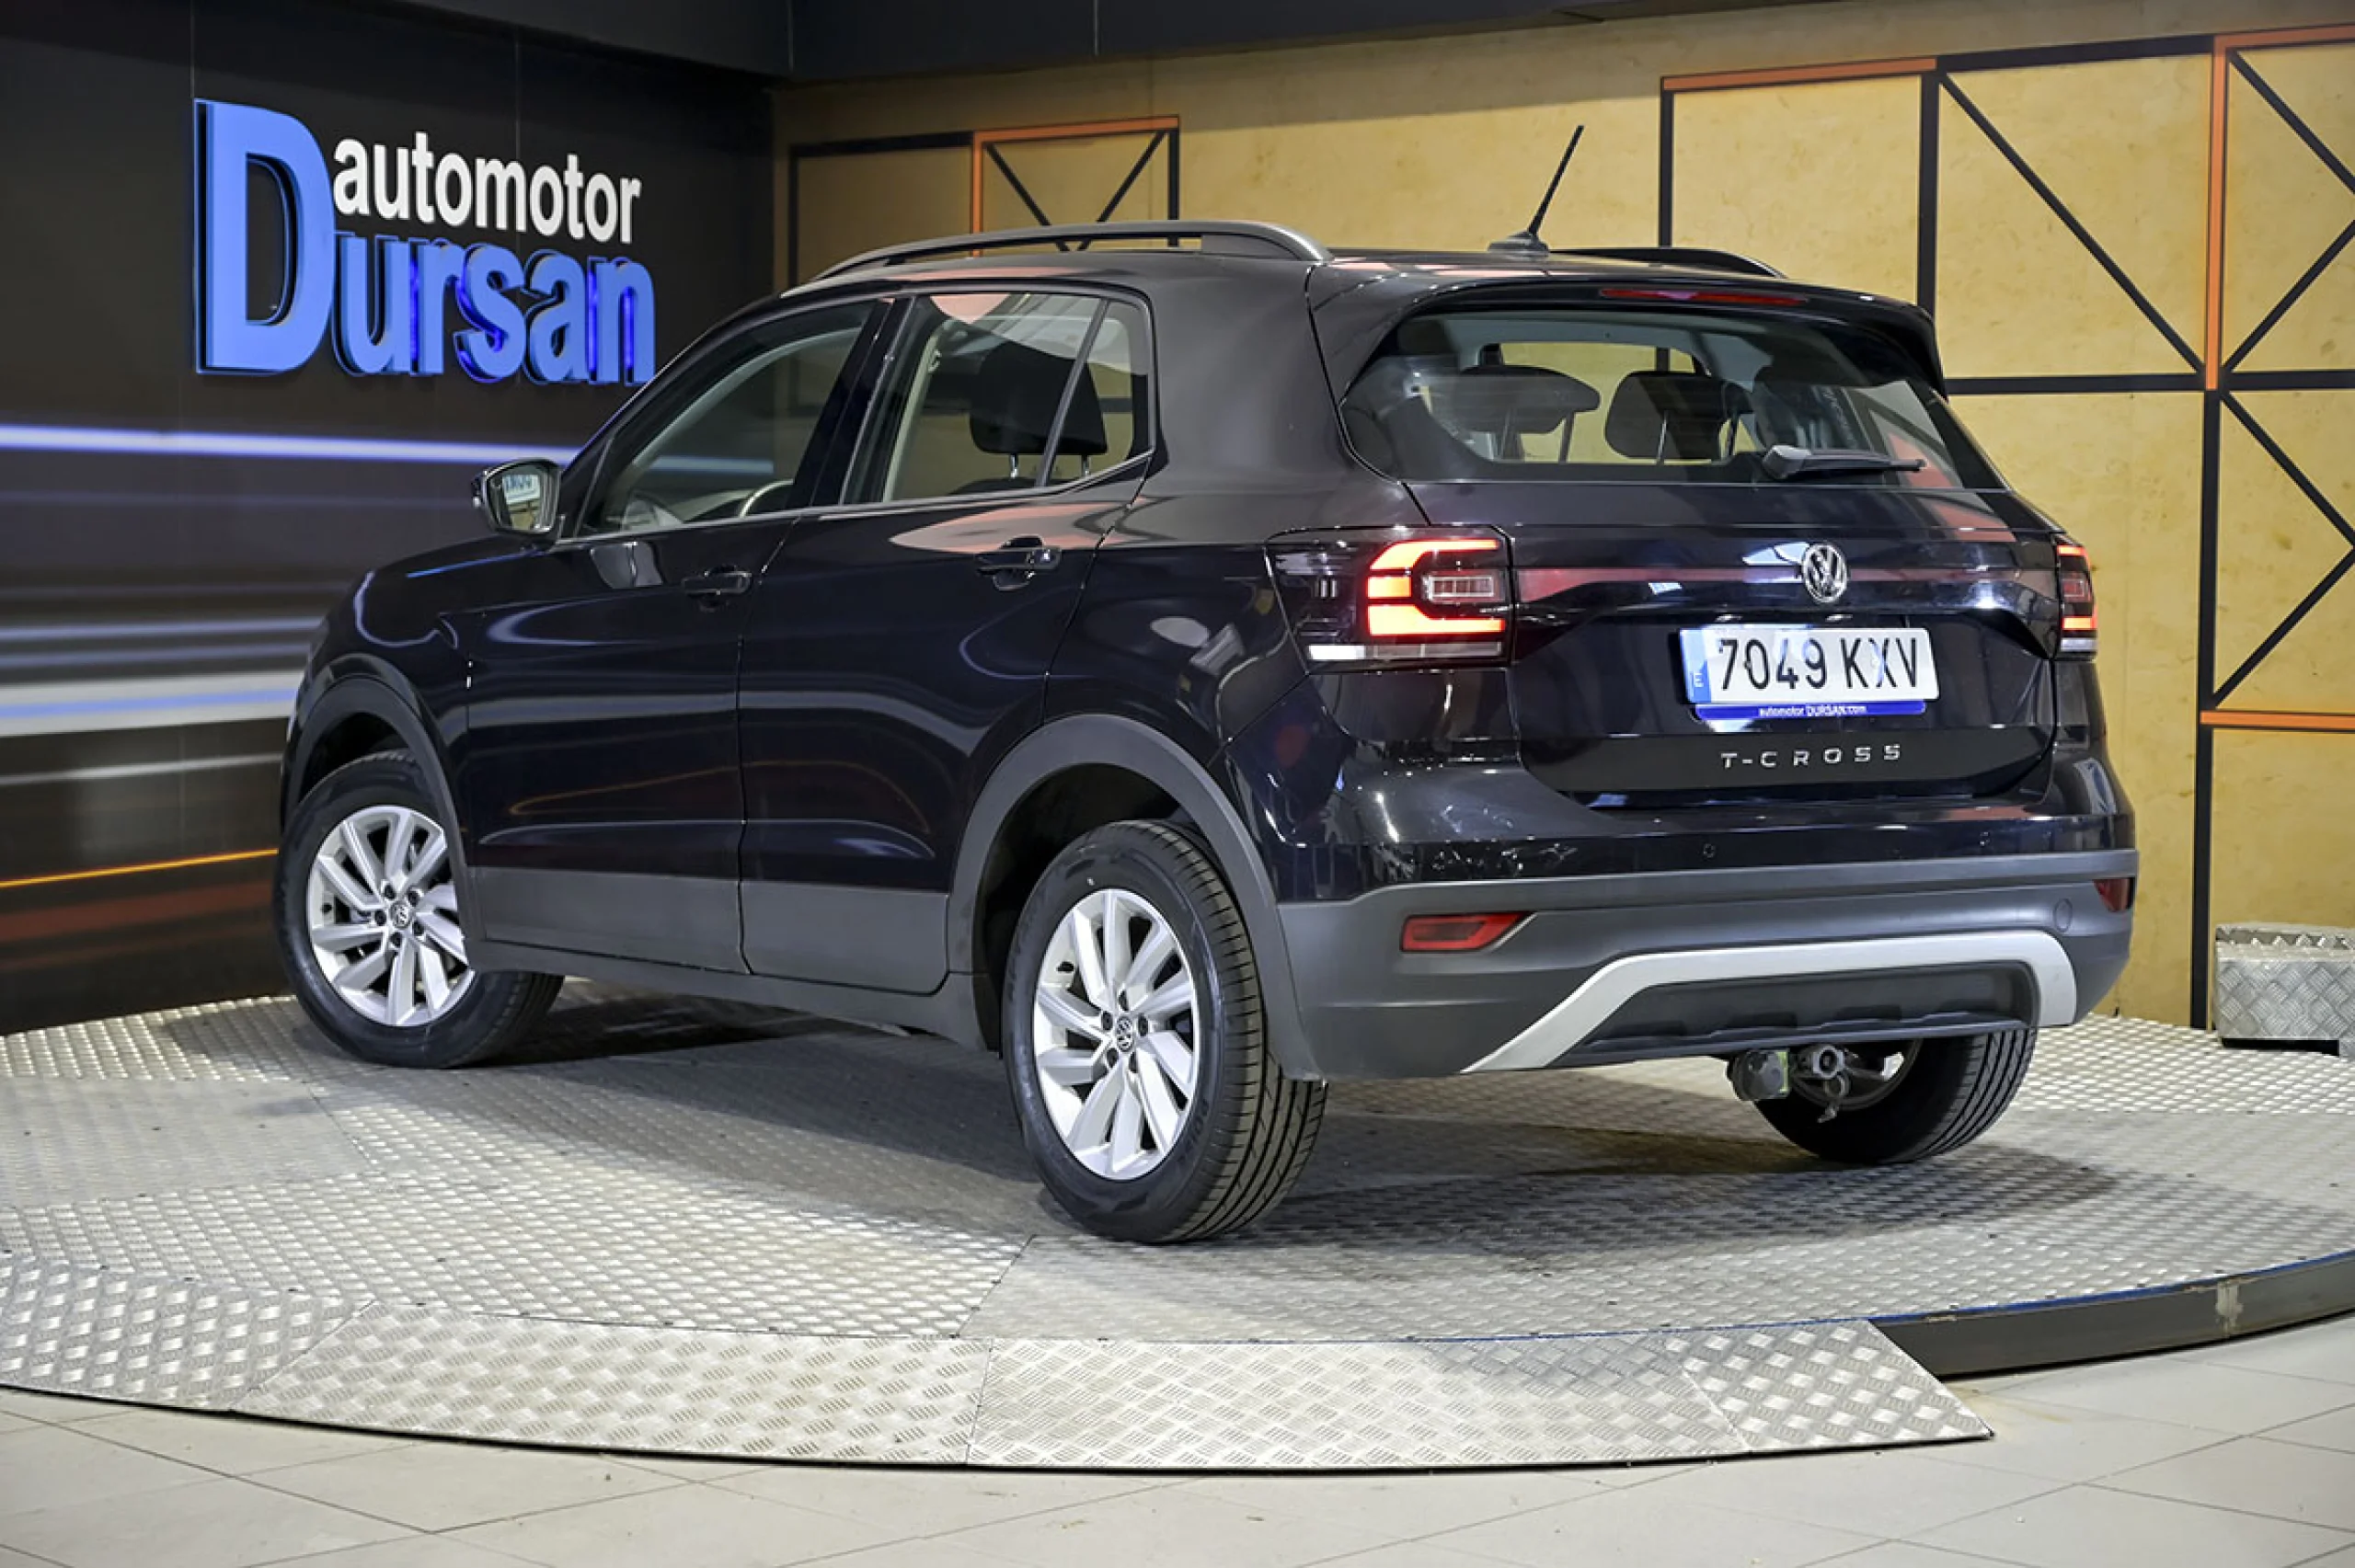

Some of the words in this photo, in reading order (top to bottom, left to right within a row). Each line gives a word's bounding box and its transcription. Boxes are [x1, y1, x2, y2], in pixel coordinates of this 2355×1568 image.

[332, 132, 642, 244] automotor
[193, 97, 656, 386] Dursan
[1718, 638, 1827, 690] 7049
[1840, 638, 1917, 688] KXV
[1720, 744, 1901, 769] T-CROSS
